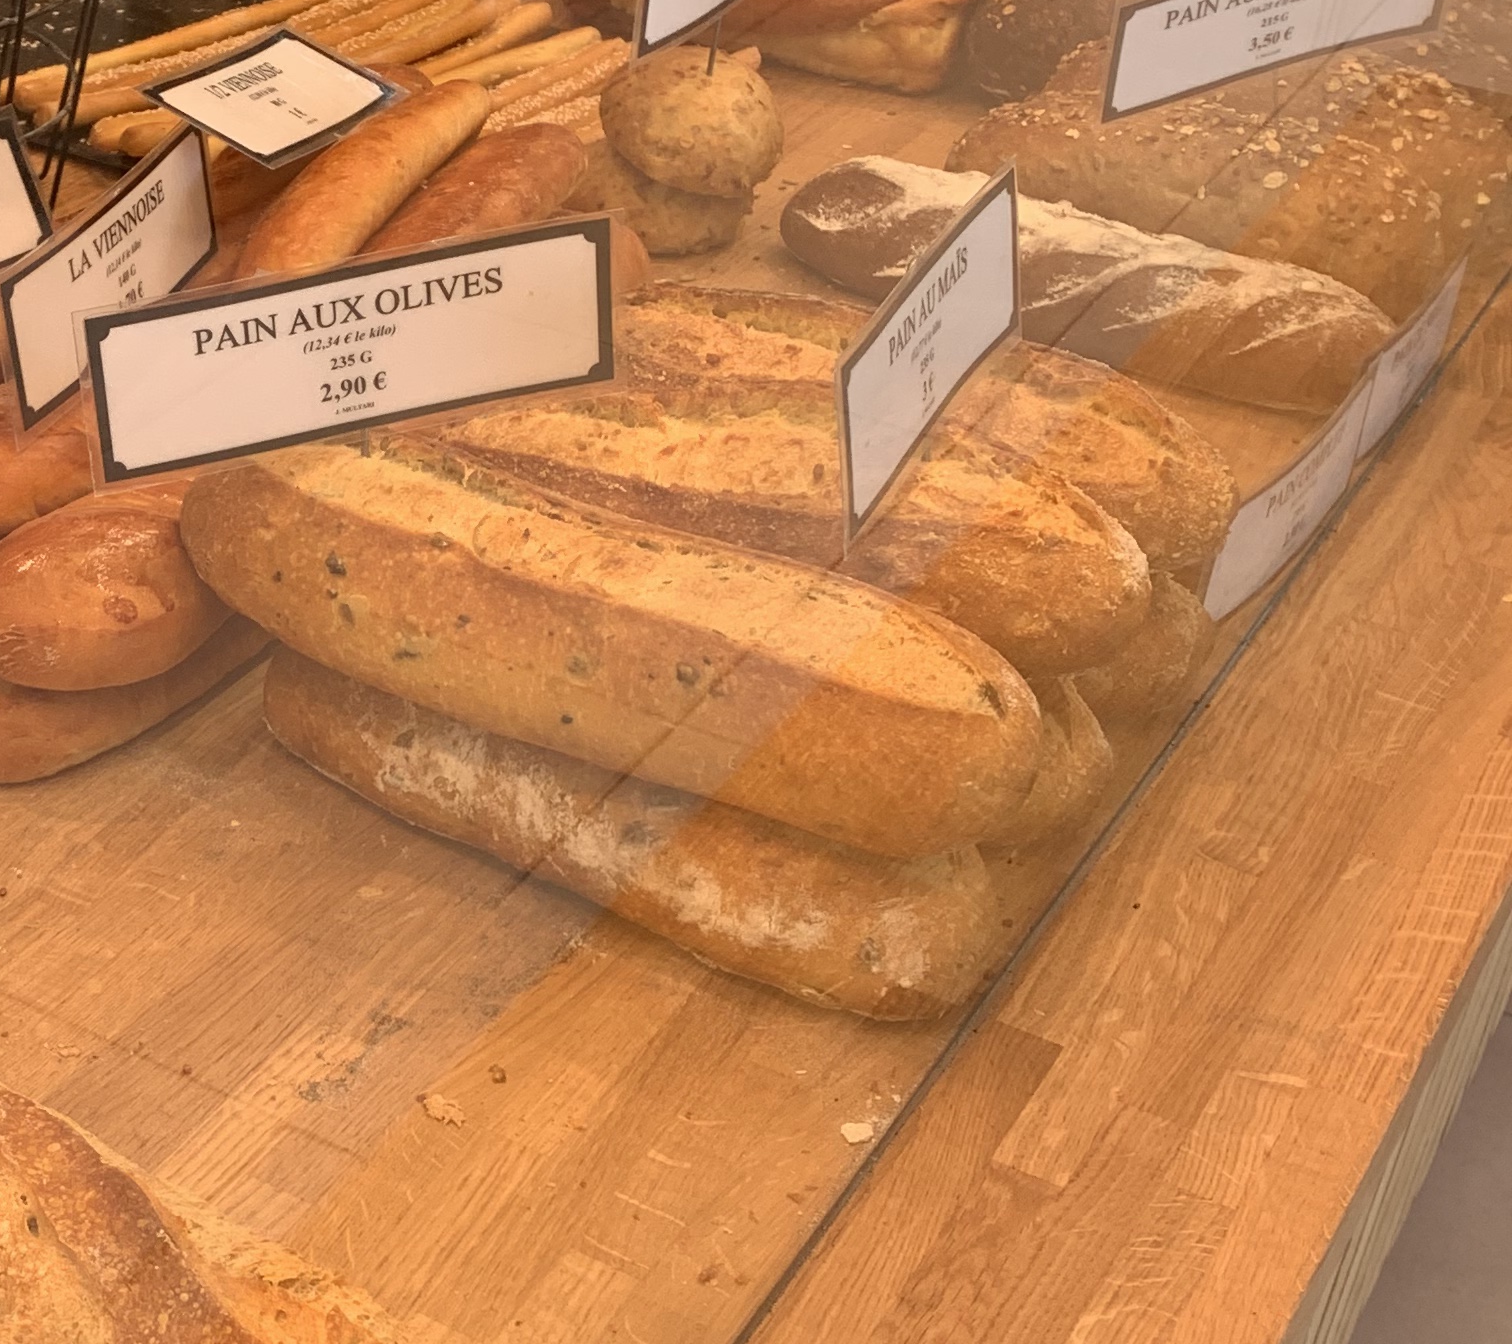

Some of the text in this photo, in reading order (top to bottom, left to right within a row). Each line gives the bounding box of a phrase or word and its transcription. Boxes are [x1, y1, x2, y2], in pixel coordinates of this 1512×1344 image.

[1280, 12, 1290, 22] G
[1248, 25, 1295, 52] 3,50 €
[217, 62, 283, 93] VIENNOISE
[68, 179, 166, 283] LA VIENNOISE
[130, 263, 137, 277] G
[137, 280, 145, 299] €
[192, 266, 504, 356] PAIN AUX OLIVES
[889, 307, 916, 367] PAIN
[918, 283, 936, 328] AU
[303, 324, 396, 354] (12,34 € le kilo)
[330, 350, 372, 370] 235 G
[320, 371, 387, 403] 2,90 €
